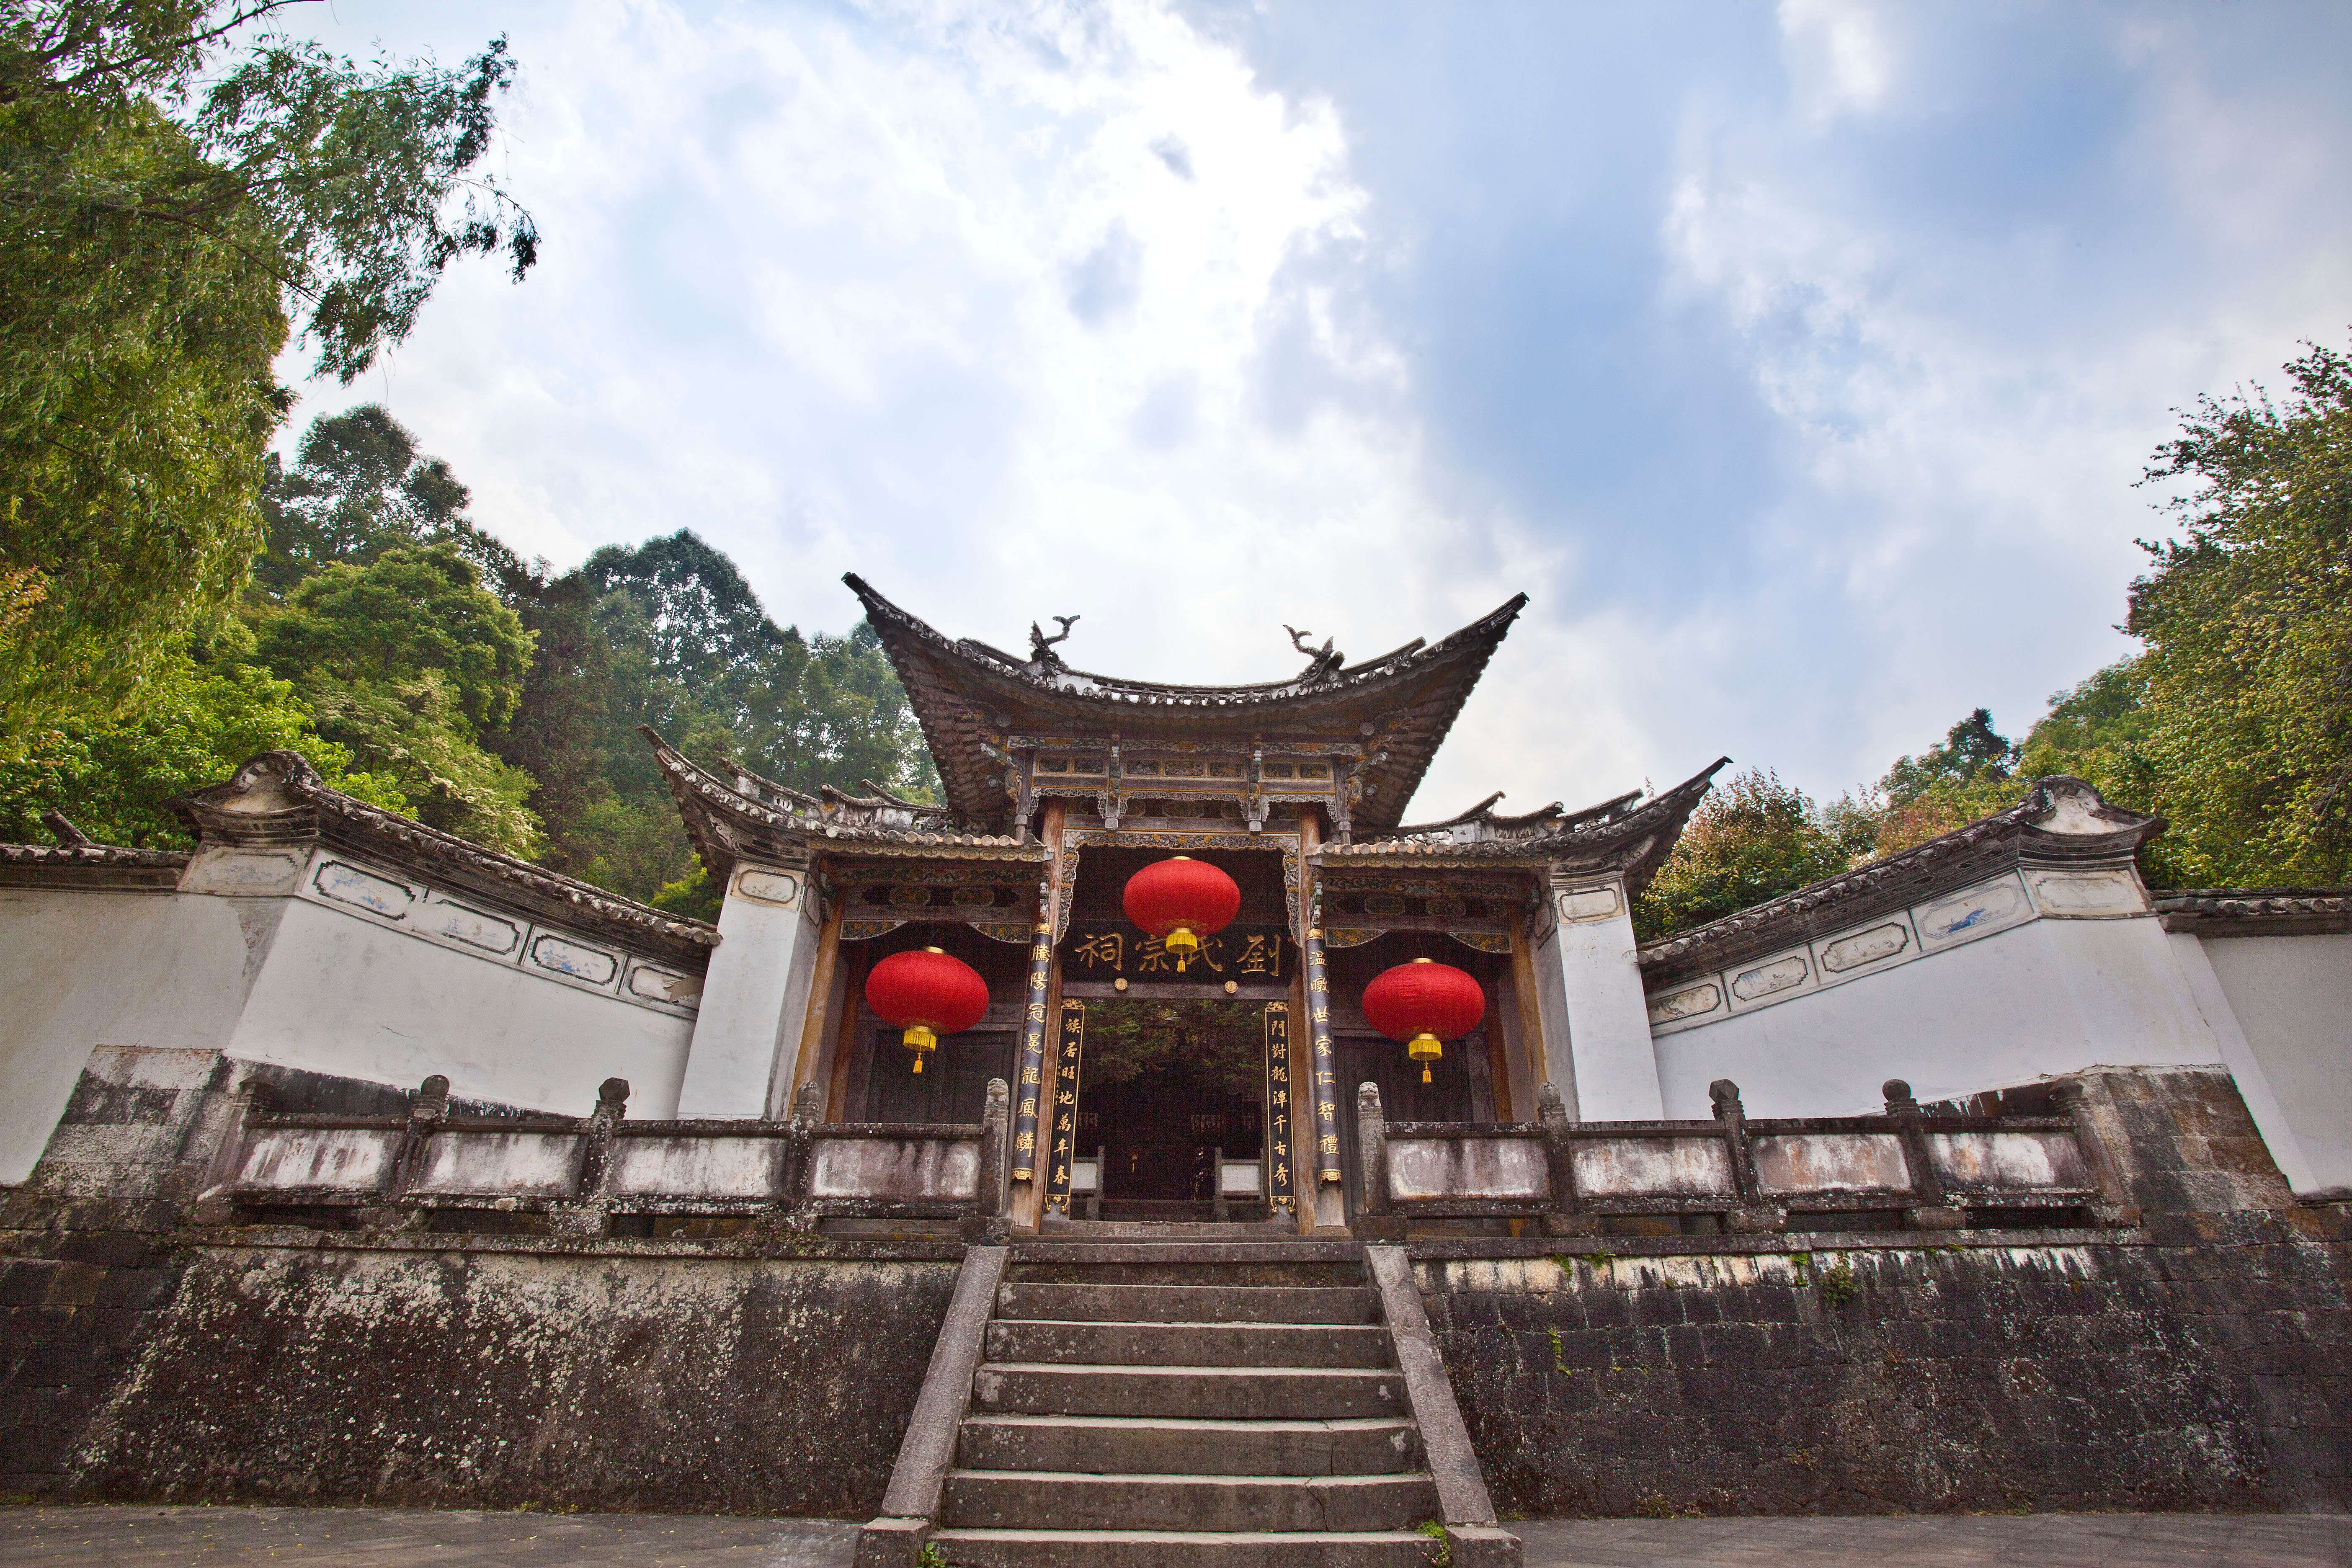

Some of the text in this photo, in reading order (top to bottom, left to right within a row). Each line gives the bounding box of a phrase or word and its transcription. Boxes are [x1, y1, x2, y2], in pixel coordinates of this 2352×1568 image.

[1270, 1021, 1289, 1186] 門對龍潭千古秀
